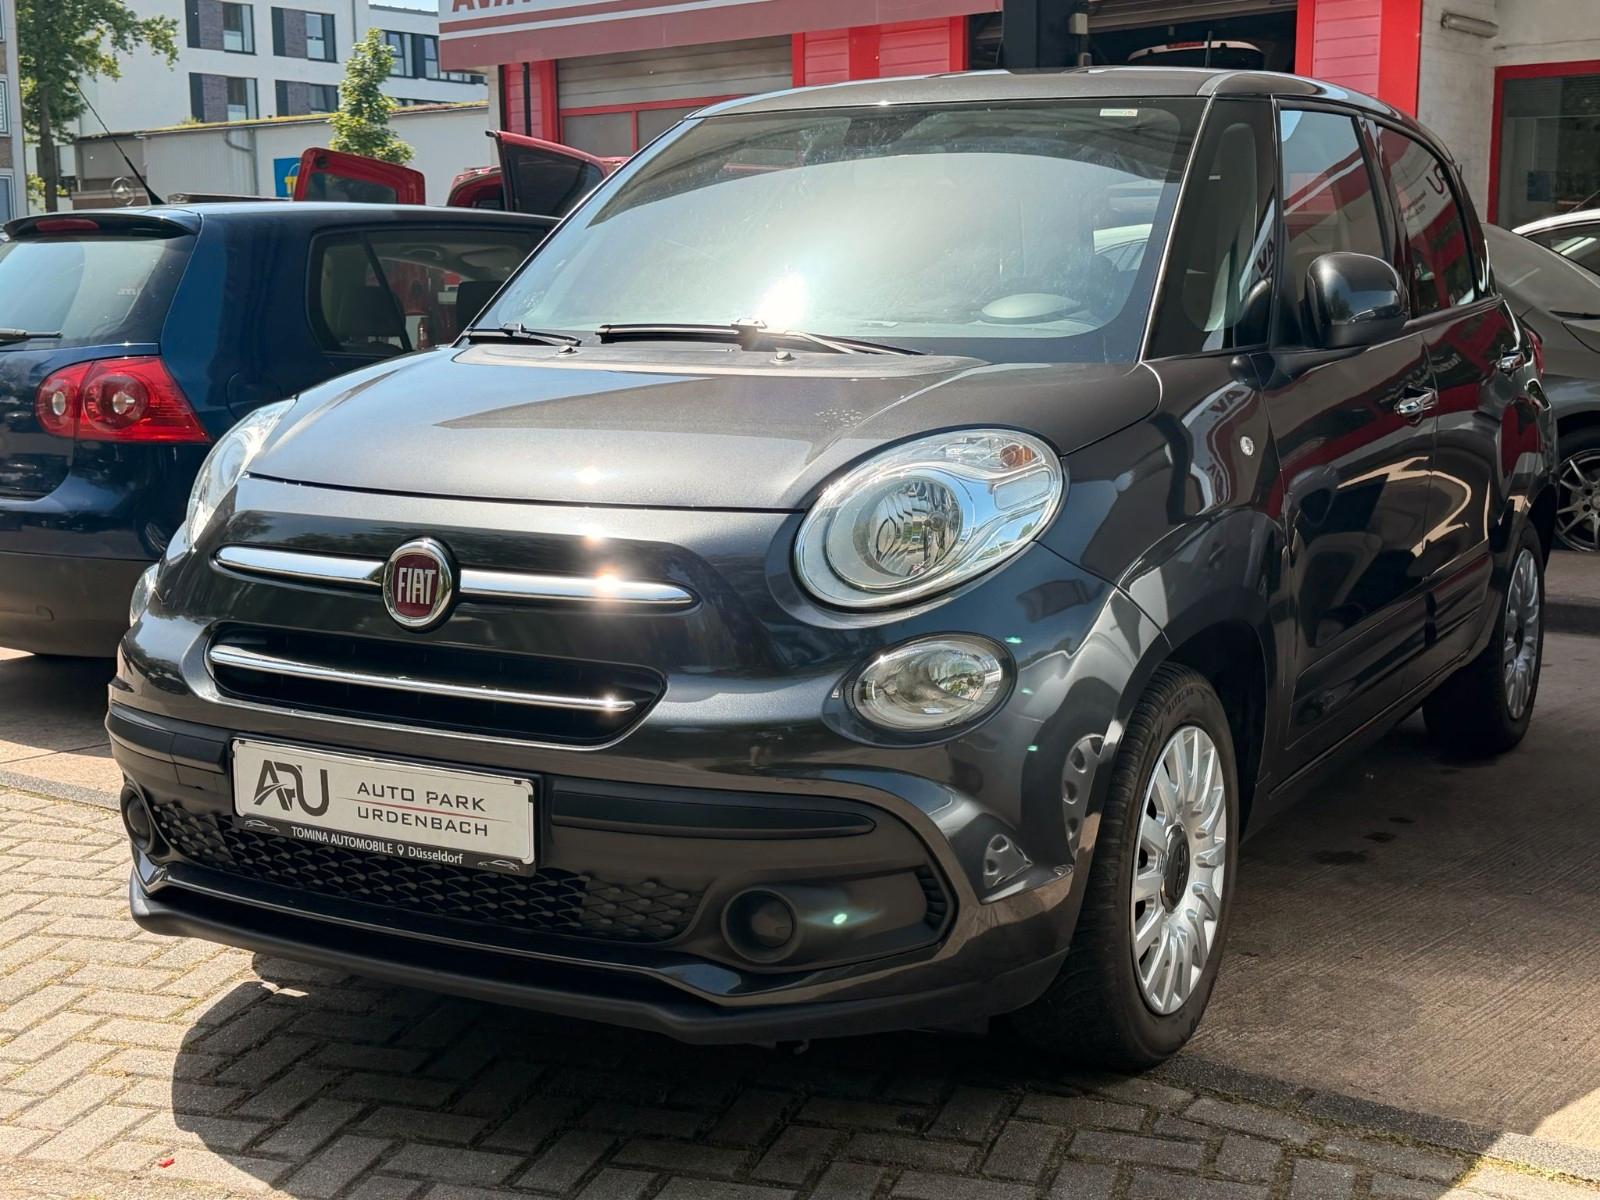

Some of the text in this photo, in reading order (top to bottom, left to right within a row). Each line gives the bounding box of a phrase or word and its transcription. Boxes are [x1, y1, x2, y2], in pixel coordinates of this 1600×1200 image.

[397, 567, 437, 605] FIAT
[357, 782, 486, 812] AUTO PARK
[357, 806, 488, 837] URDENBACH
[291, 826, 464, 865] TOMINA AUTOMOBILE Düsseldorf
